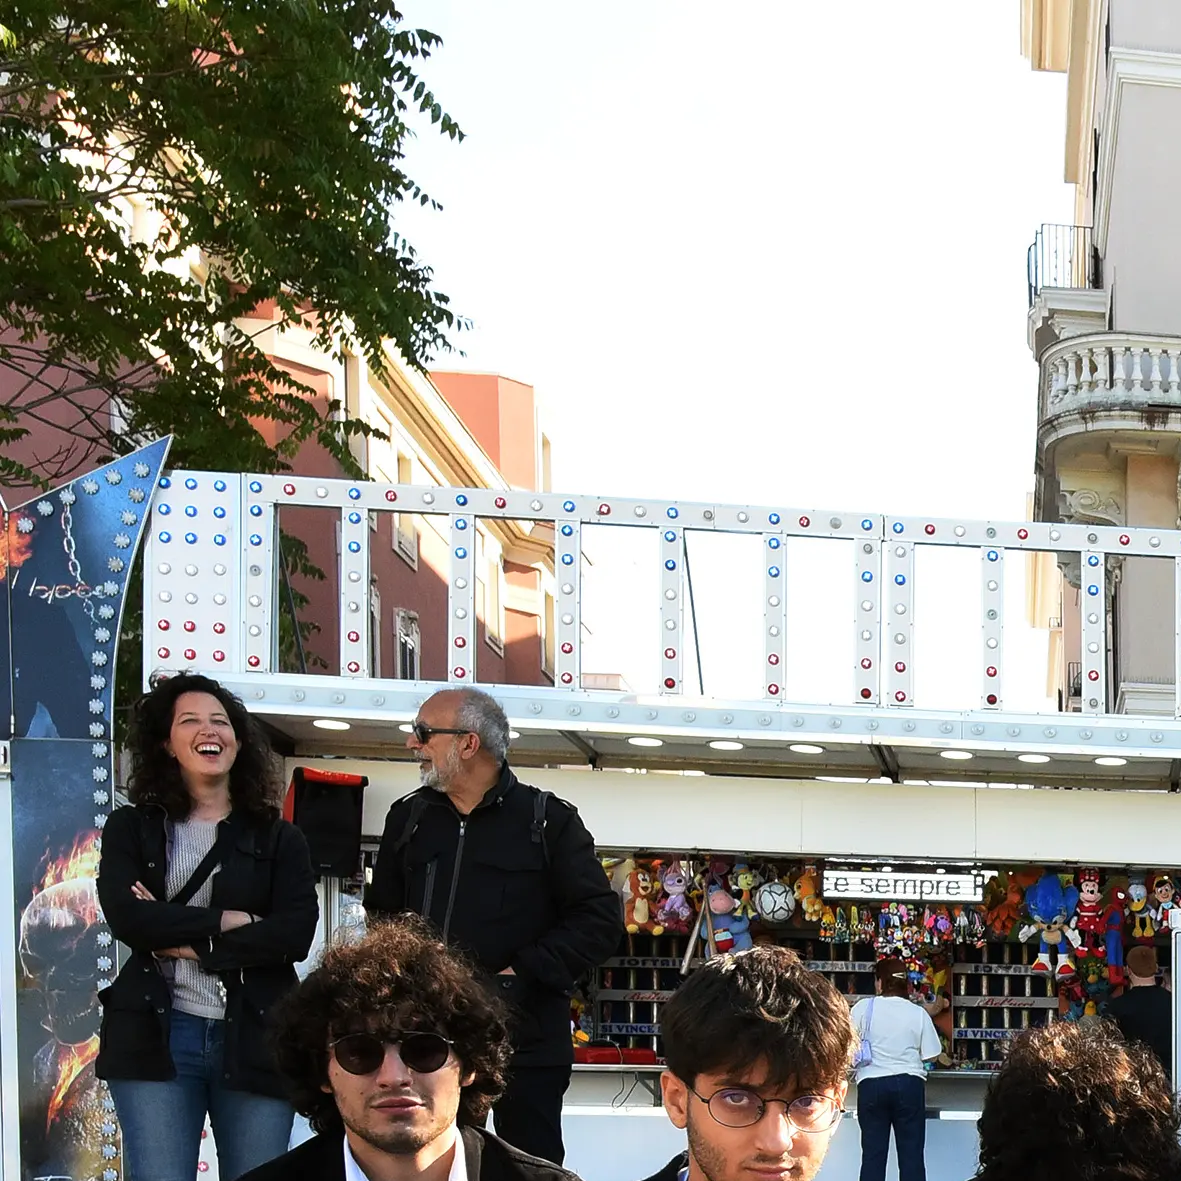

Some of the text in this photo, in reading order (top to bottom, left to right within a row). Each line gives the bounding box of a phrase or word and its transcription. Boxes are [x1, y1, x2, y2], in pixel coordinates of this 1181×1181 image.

[860, 876, 962, 899] sempre
[601, 1024, 613, 1033] SI
[616, 1024, 656, 1033] VINCE
[956, 1029, 1008, 1039] SI VINCE
